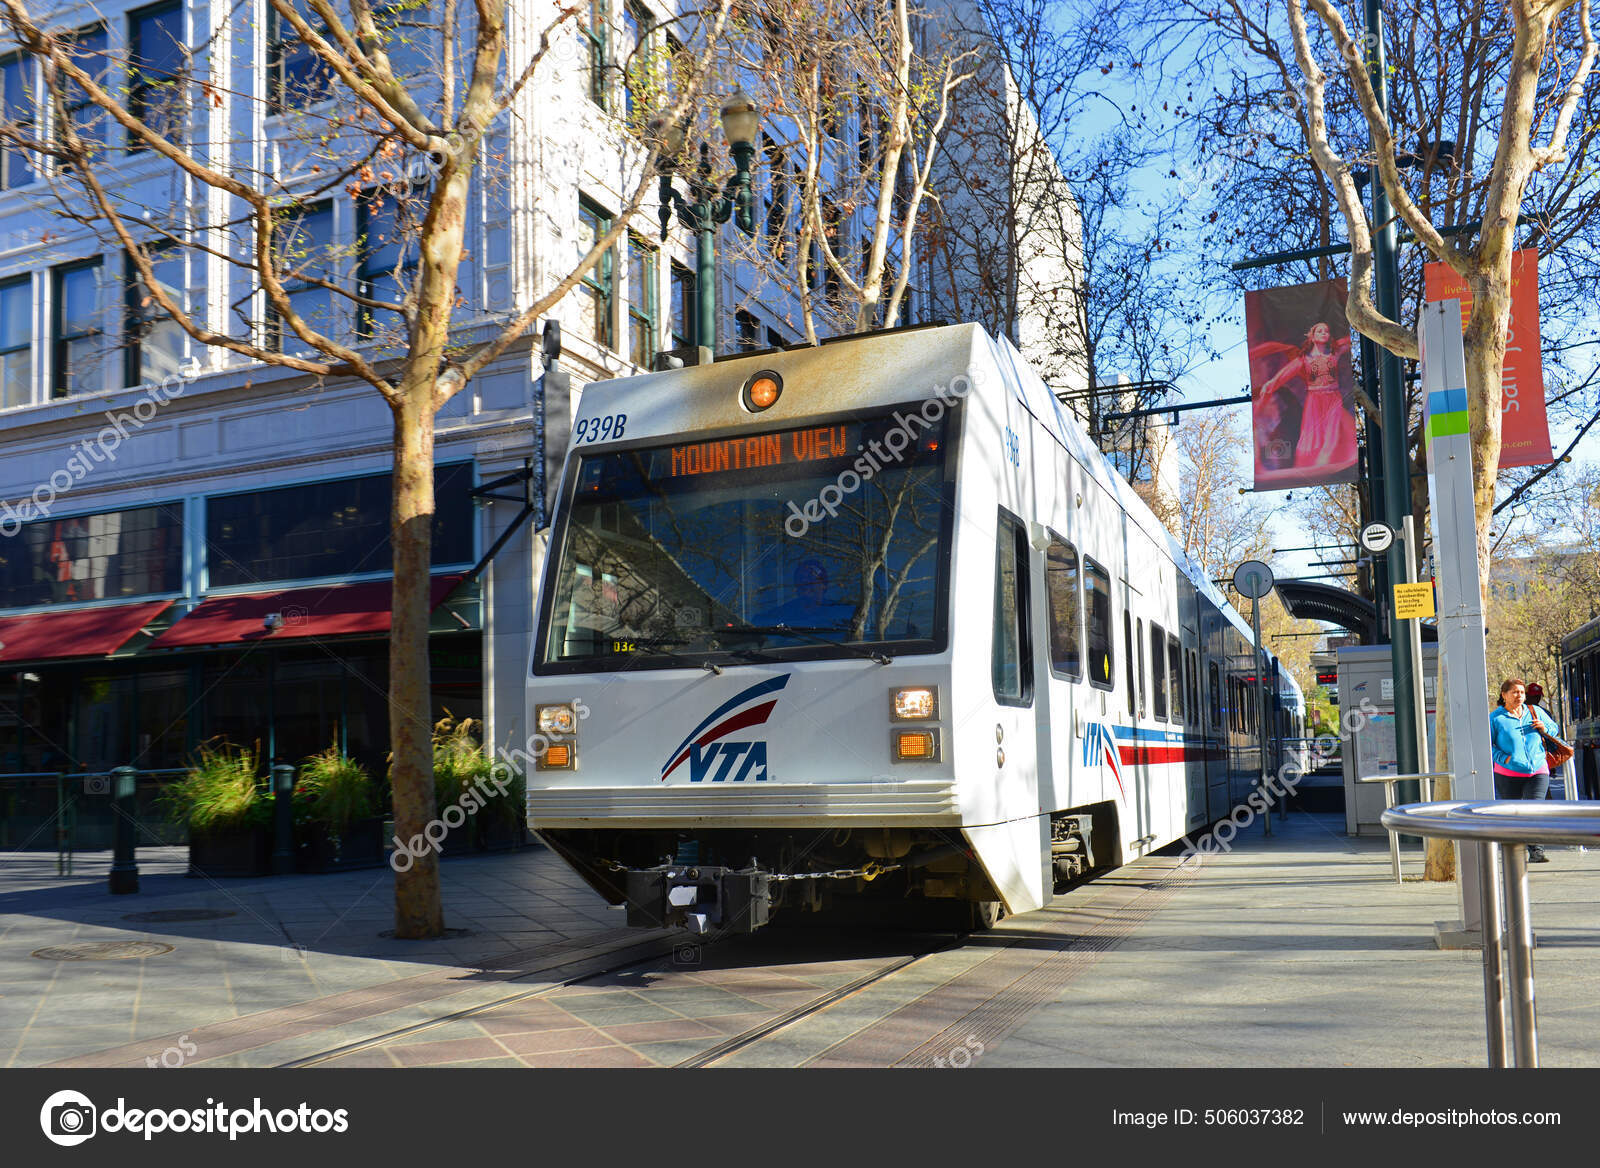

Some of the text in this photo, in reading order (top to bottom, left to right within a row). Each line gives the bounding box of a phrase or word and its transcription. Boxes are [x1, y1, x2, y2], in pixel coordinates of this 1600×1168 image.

[575, 414, 627, 444] 939B
[671, 425, 848, 477] MOUNTAIN VIEW
[689, 741, 768, 783] VTA
[1082, 722, 1103, 768] VTA
